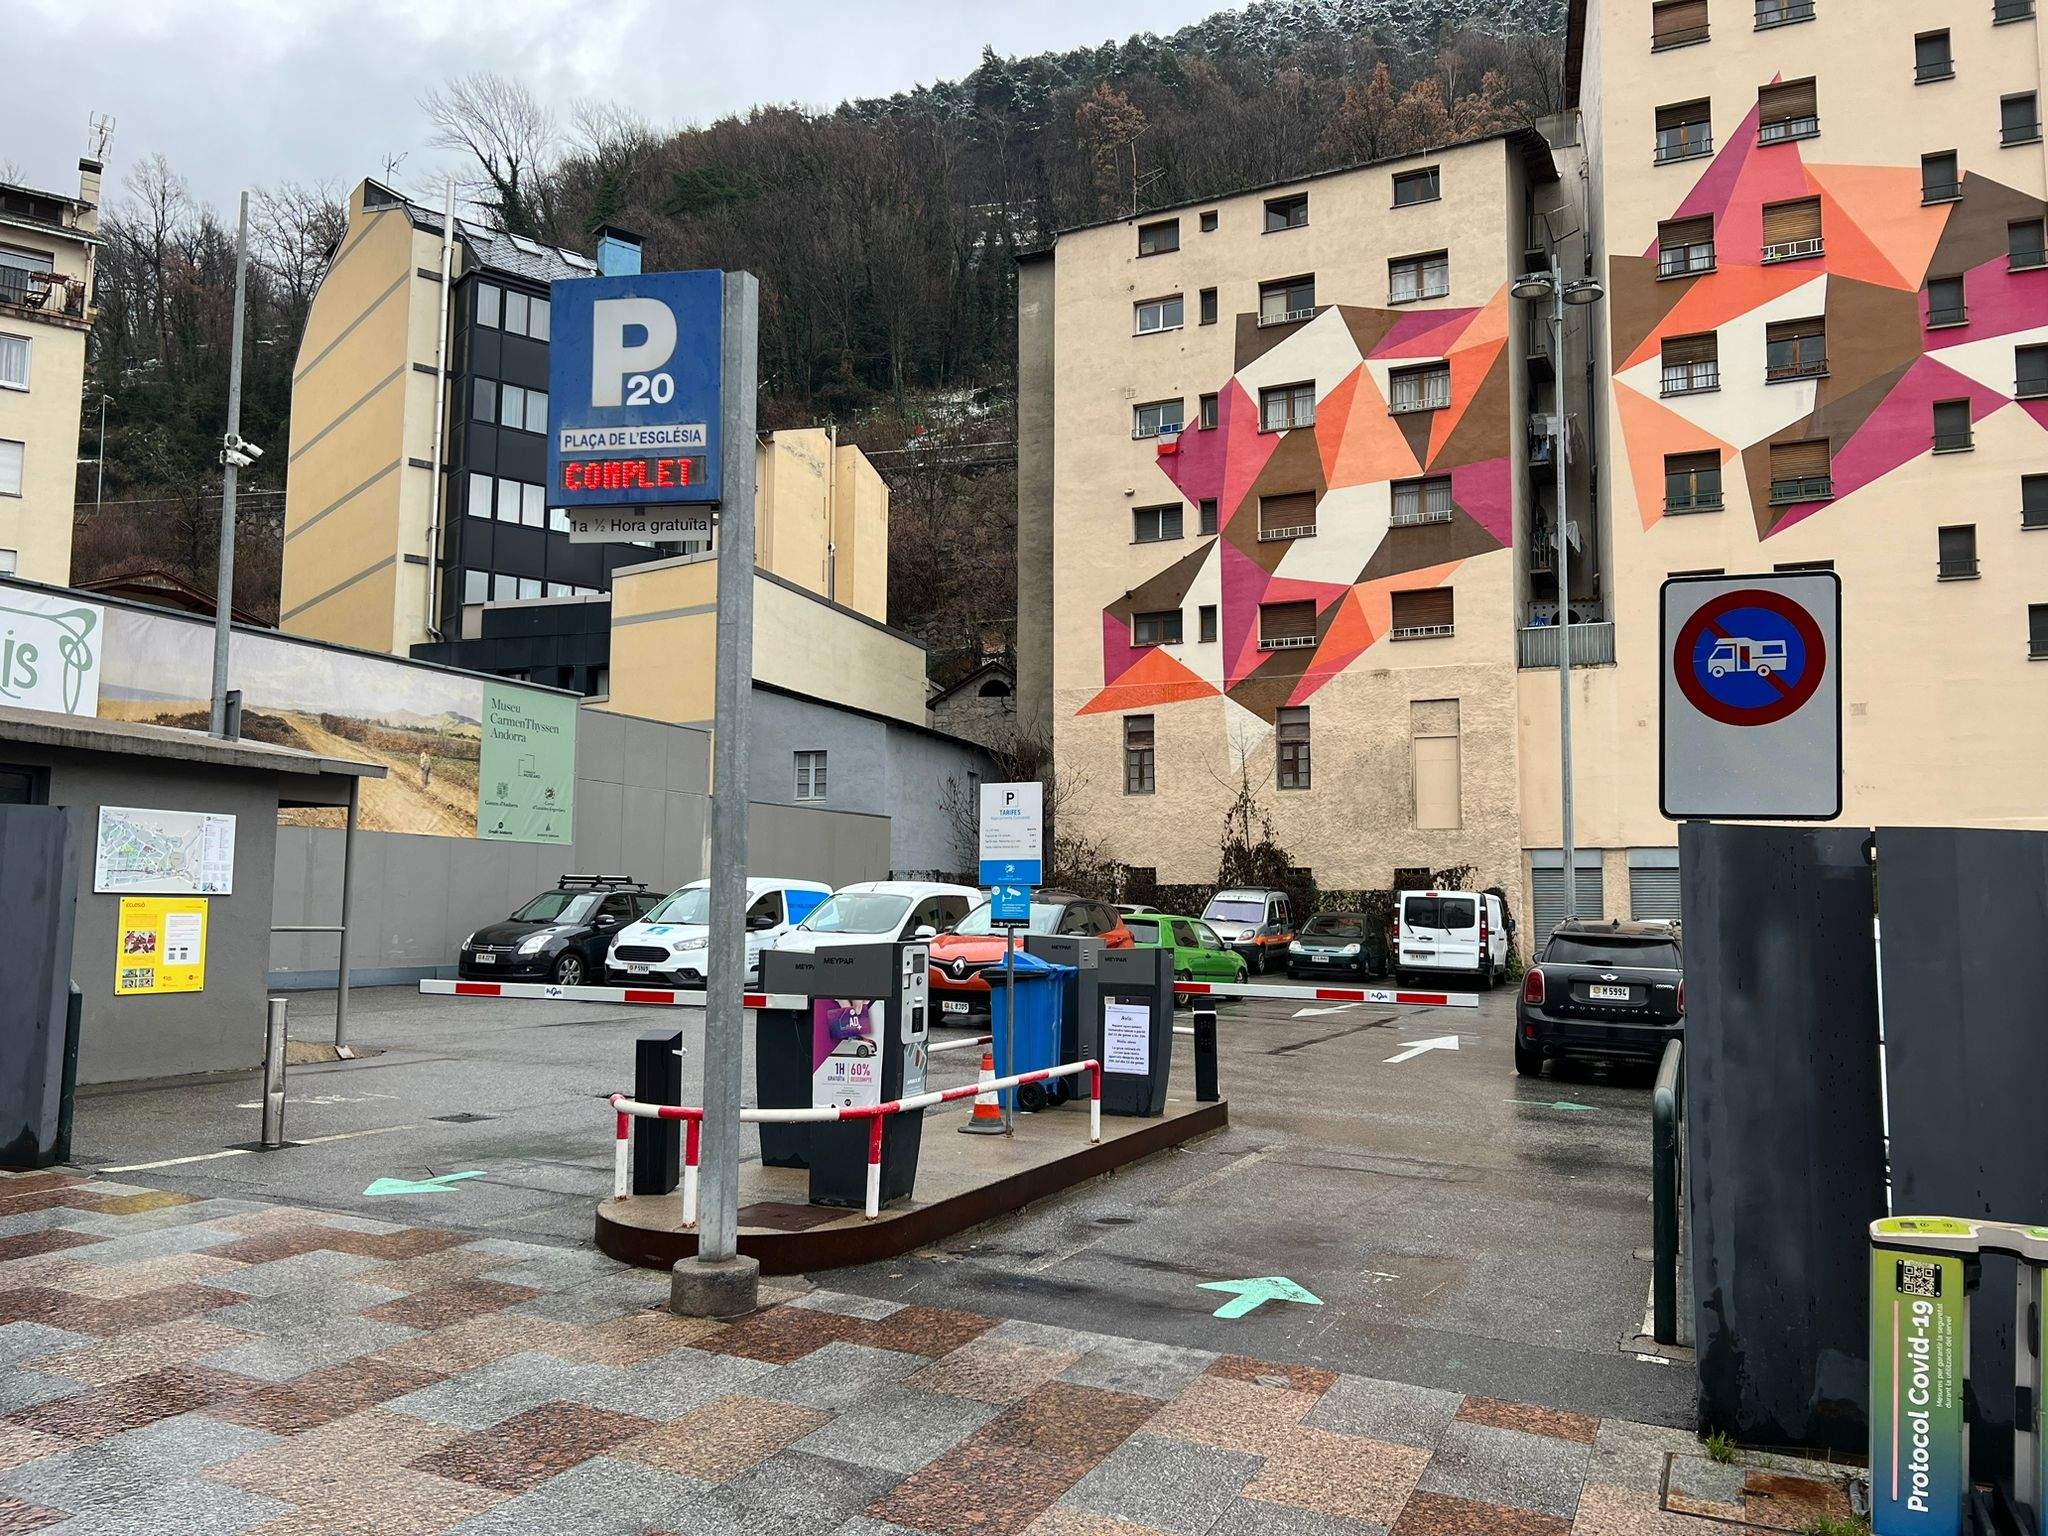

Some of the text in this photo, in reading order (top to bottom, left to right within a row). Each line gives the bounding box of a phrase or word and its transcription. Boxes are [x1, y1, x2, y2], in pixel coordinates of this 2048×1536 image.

[592, 297, 678, 408] P 20
[564, 426, 702, 450] PLAÇA DE L'ESGLÉSIA
[565, 458, 693, 492] COMPLET
[571, 520, 588, 533] 1a
[610, 519, 646, 533] Hora
[650, 517, 708, 535] gratuïta
[491, 697, 521, 714] Museu
[490, 727, 527, 743] Andorra
[1006, 792, 1015, 806] P
[795, 963, 815, 971] MEYP
[823, 957, 854, 966] MEYPAR
[835, 1063, 845, 1075] 1H
[850, 1063, 871, 1076] 60%
[1907, 1300, 1934, 1513] Protocol Covid-19
